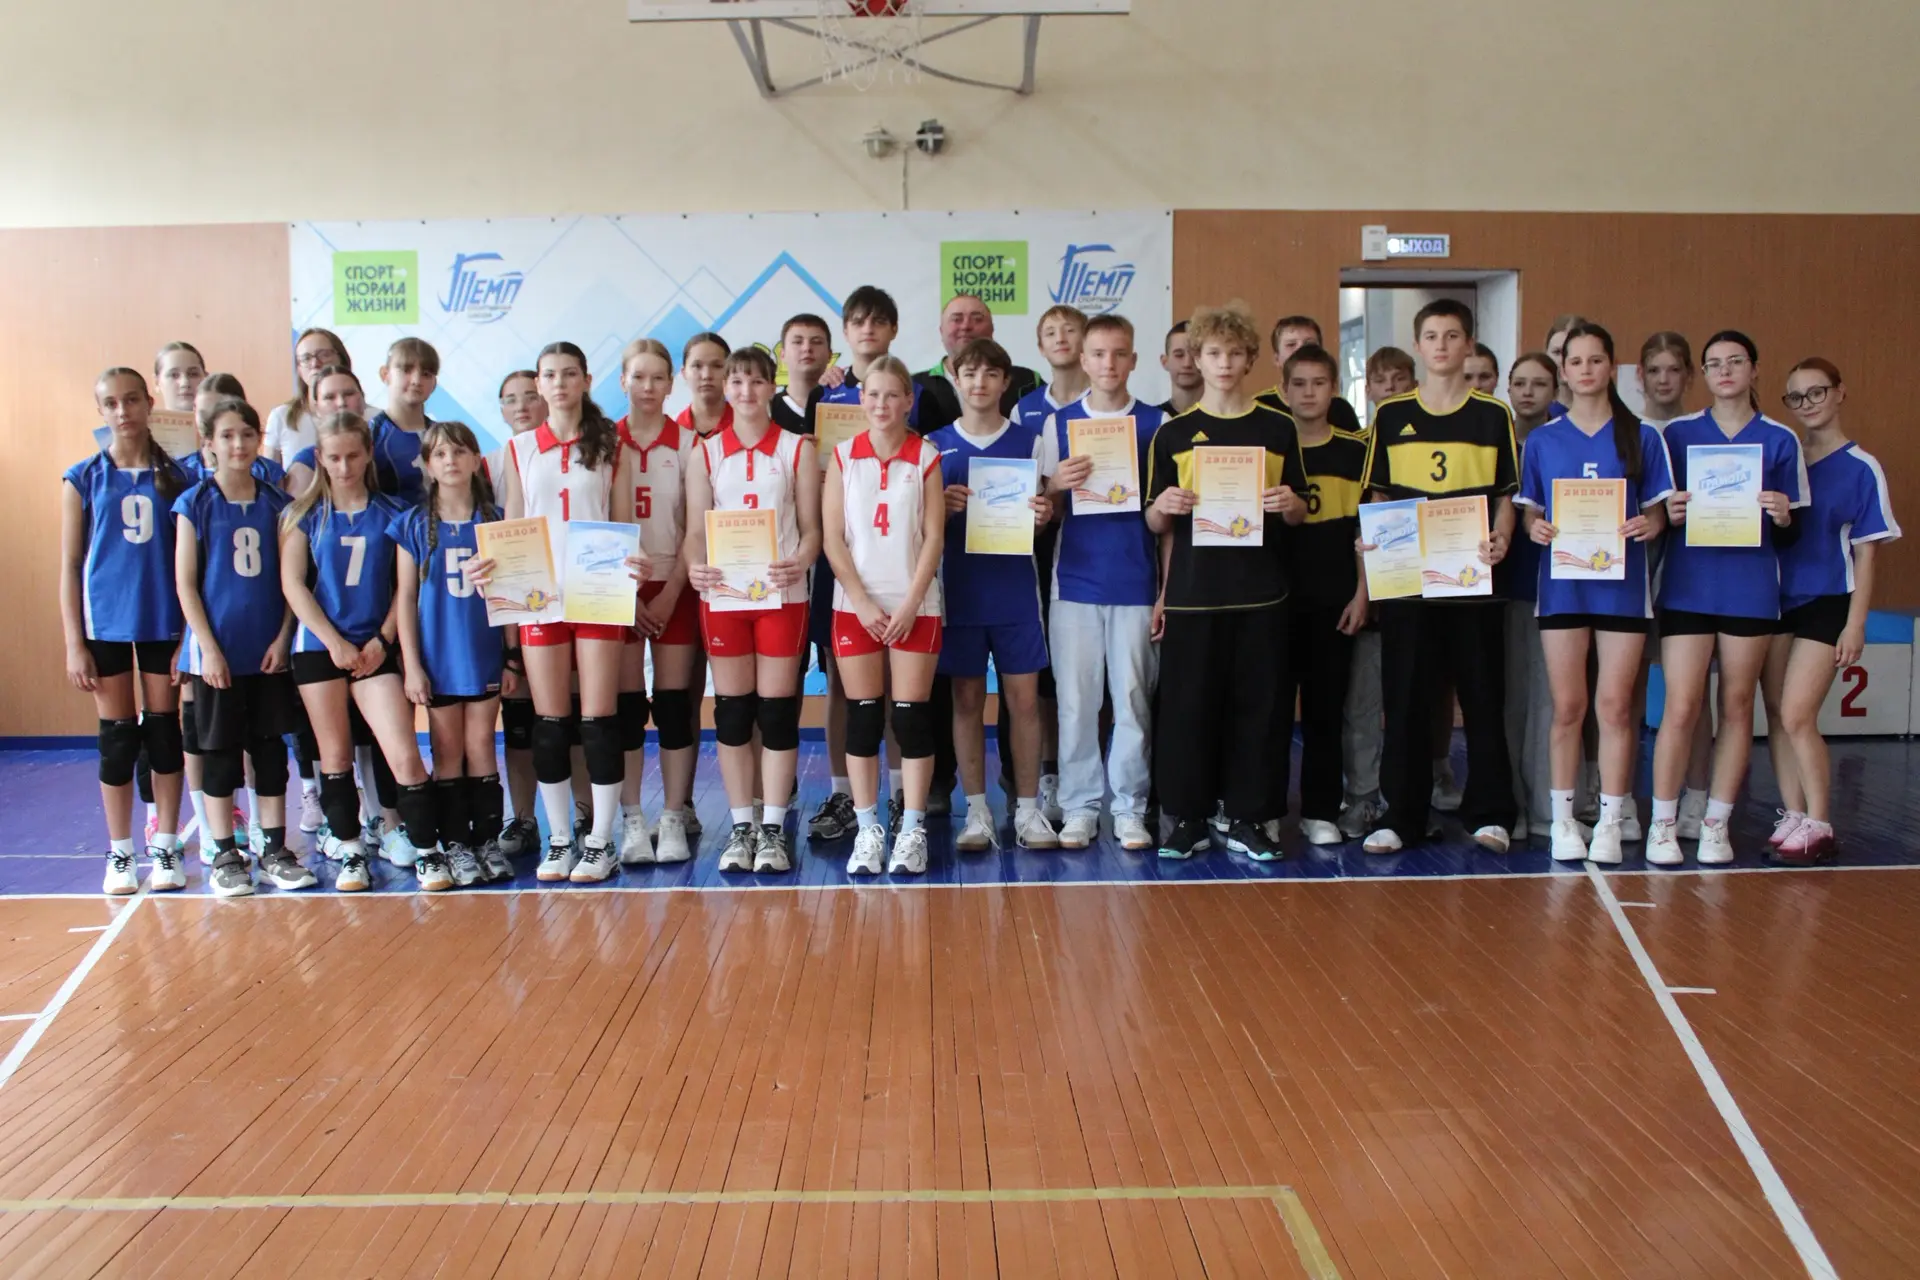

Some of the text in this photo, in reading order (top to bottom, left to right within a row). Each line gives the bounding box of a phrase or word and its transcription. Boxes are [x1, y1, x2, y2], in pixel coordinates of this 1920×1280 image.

[1387, 238, 1442, 254] ЫХОД
[345, 265, 395, 280] СПОРТ
[953, 255, 1004, 270] СПОРТ
[345, 281, 406, 297] НОРМА
[953, 271, 1015, 287] НОРМА
[346, 297, 406, 313] ЖИЗНИ
[1204, 455, 1254, 464] ДИПЛОМ
[1430, 450, 1447, 482] 3
[558, 488, 569, 521] 1
[635, 486, 651, 518] 5
[1307, 483, 1321, 515] 6
[1563, 488, 1614, 497] ДИПЛОМ
[121, 494, 153, 544] 9
[489, 526, 538, 540] ДИПЛОМ
[873, 503, 889, 536] 4
[233, 527, 261, 577] 8
[340, 536, 366, 586] 7
[445, 548, 475, 598] 5
[1841, 665, 1868, 717] 2
